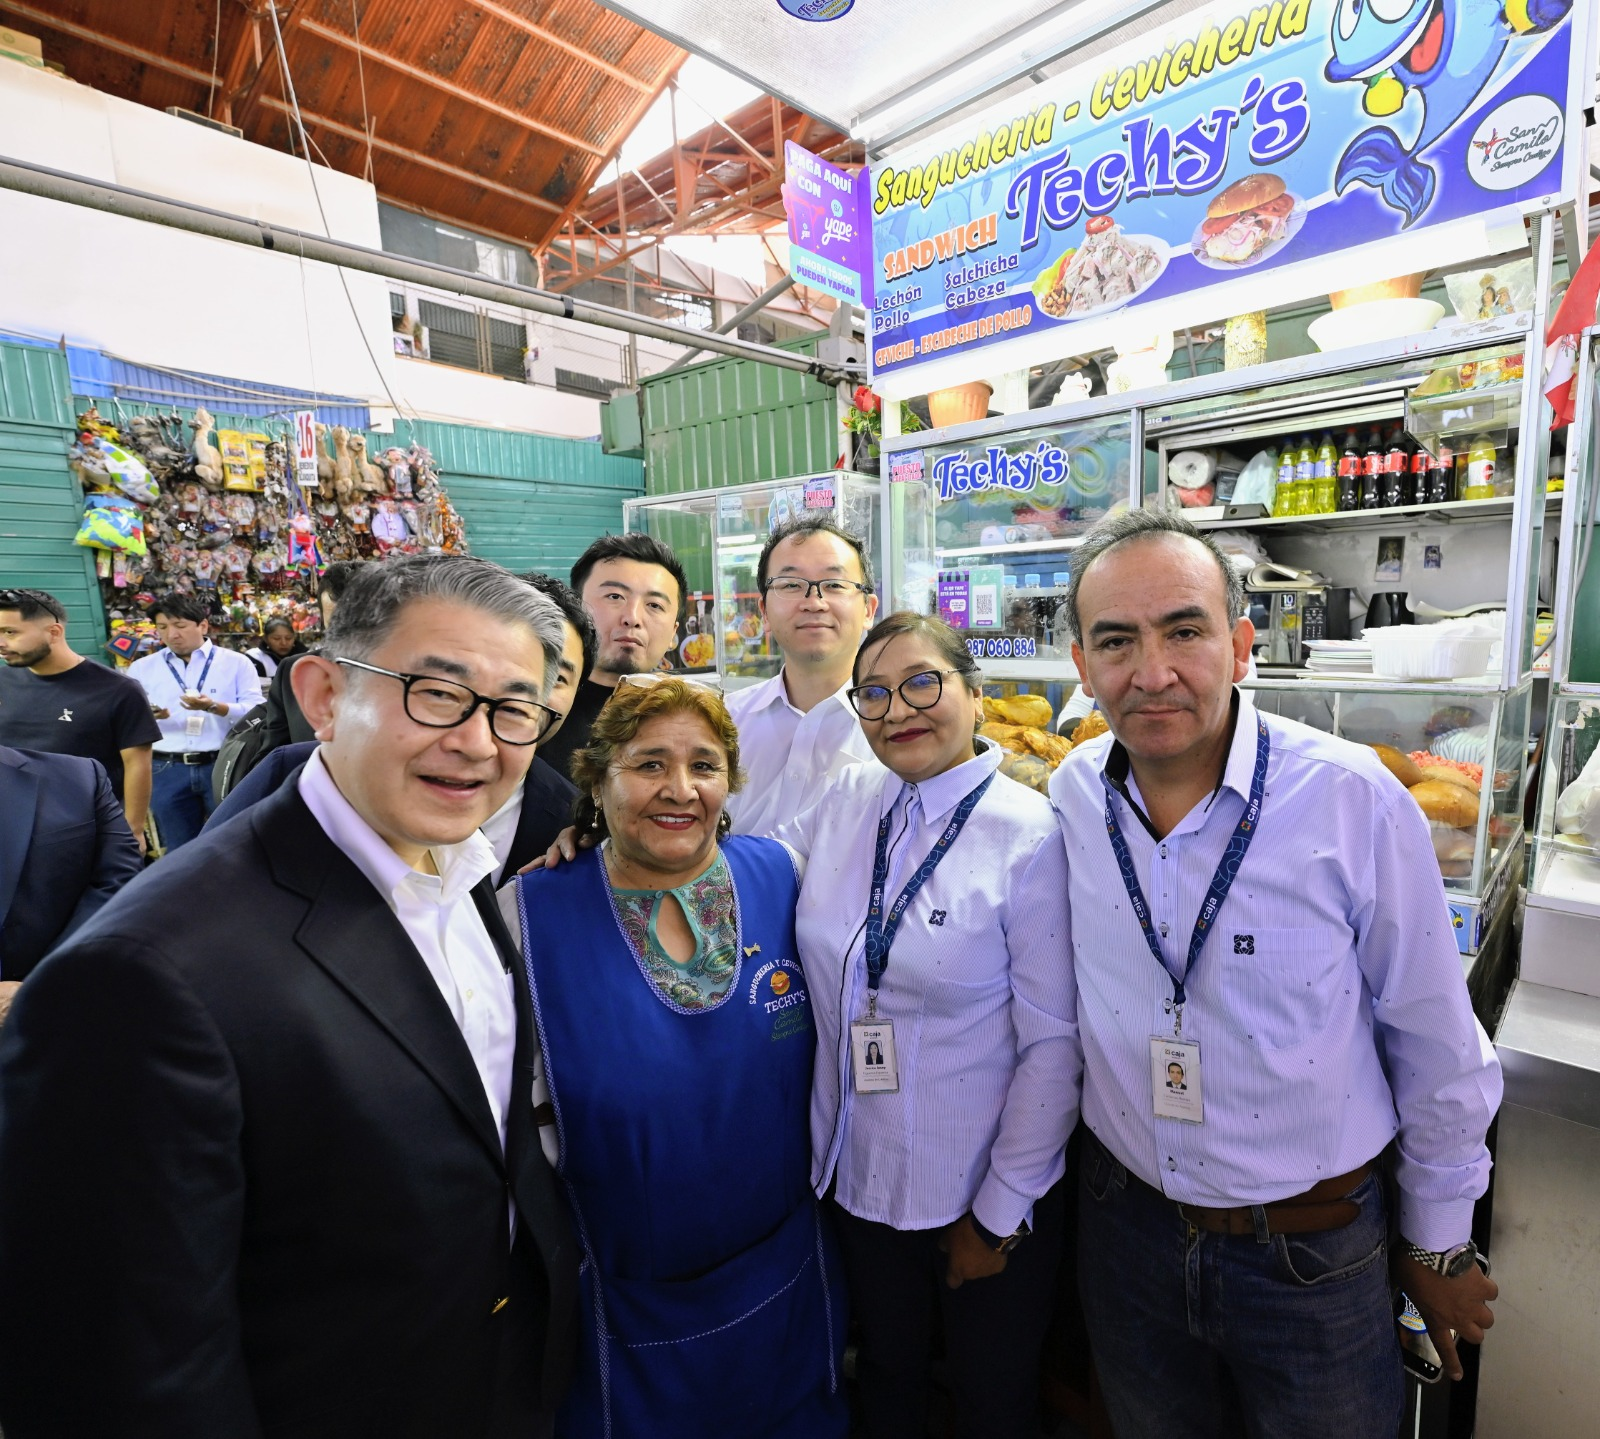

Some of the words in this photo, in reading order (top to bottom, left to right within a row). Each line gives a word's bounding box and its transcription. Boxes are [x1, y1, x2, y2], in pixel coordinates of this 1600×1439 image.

[874, 98, 1056, 214] Sangucheria
[1494, 130, 1550, 160] Camilo
[789, 148, 822, 178] PAGA
[823, 168, 852, 194] AQUÍ
[1005, 75, 1310, 250] Techy's
[797, 175, 821, 198] CON
[822, 216, 853, 246] yape
[883, 212, 998, 282] SANDWICH
[796, 265, 827, 286] PUEDEN
[827, 276, 856, 298] YAPEAR
[800, 256, 828, 274] AHORA
[828, 268, 853, 285] TODOS
[944, 253, 1018, 290] Salchicha
[874, 285, 922, 312] Lechón
[945, 280, 1006, 310] Cabeza
[874, 309, 911, 331] Pollo
[874, 340, 915, 367] CEVICHE
[921, 319, 978, 354] ESCABECHE
[979, 317, 994, 338] DE
[995, 305, 1033, 333] POLLO
[299, 413, 313, 458] 16
[892, 463, 921, 474] PUESTO
[932, 441, 1070, 501] Techy's
[806, 490, 833, 501] PUESTO
[1282, 594, 1294, 605] 10
[987, 638, 1012, 657] 060
[1013, 637, 1037, 657] 884
[1248, 798, 1259, 821] caja
[944, 823, 957, 840] caja
[872, 887, 881, 906] caja
[894, 894, 908, 912] caja
[1133, 896, 1144, 918] caja
[1204, 897, 1217, 920] caja
[774, 959, 780, 967] Y
[764, 990, 806, 1014] TECHY'S
[1171, 1050, 1185, 1058] caja
